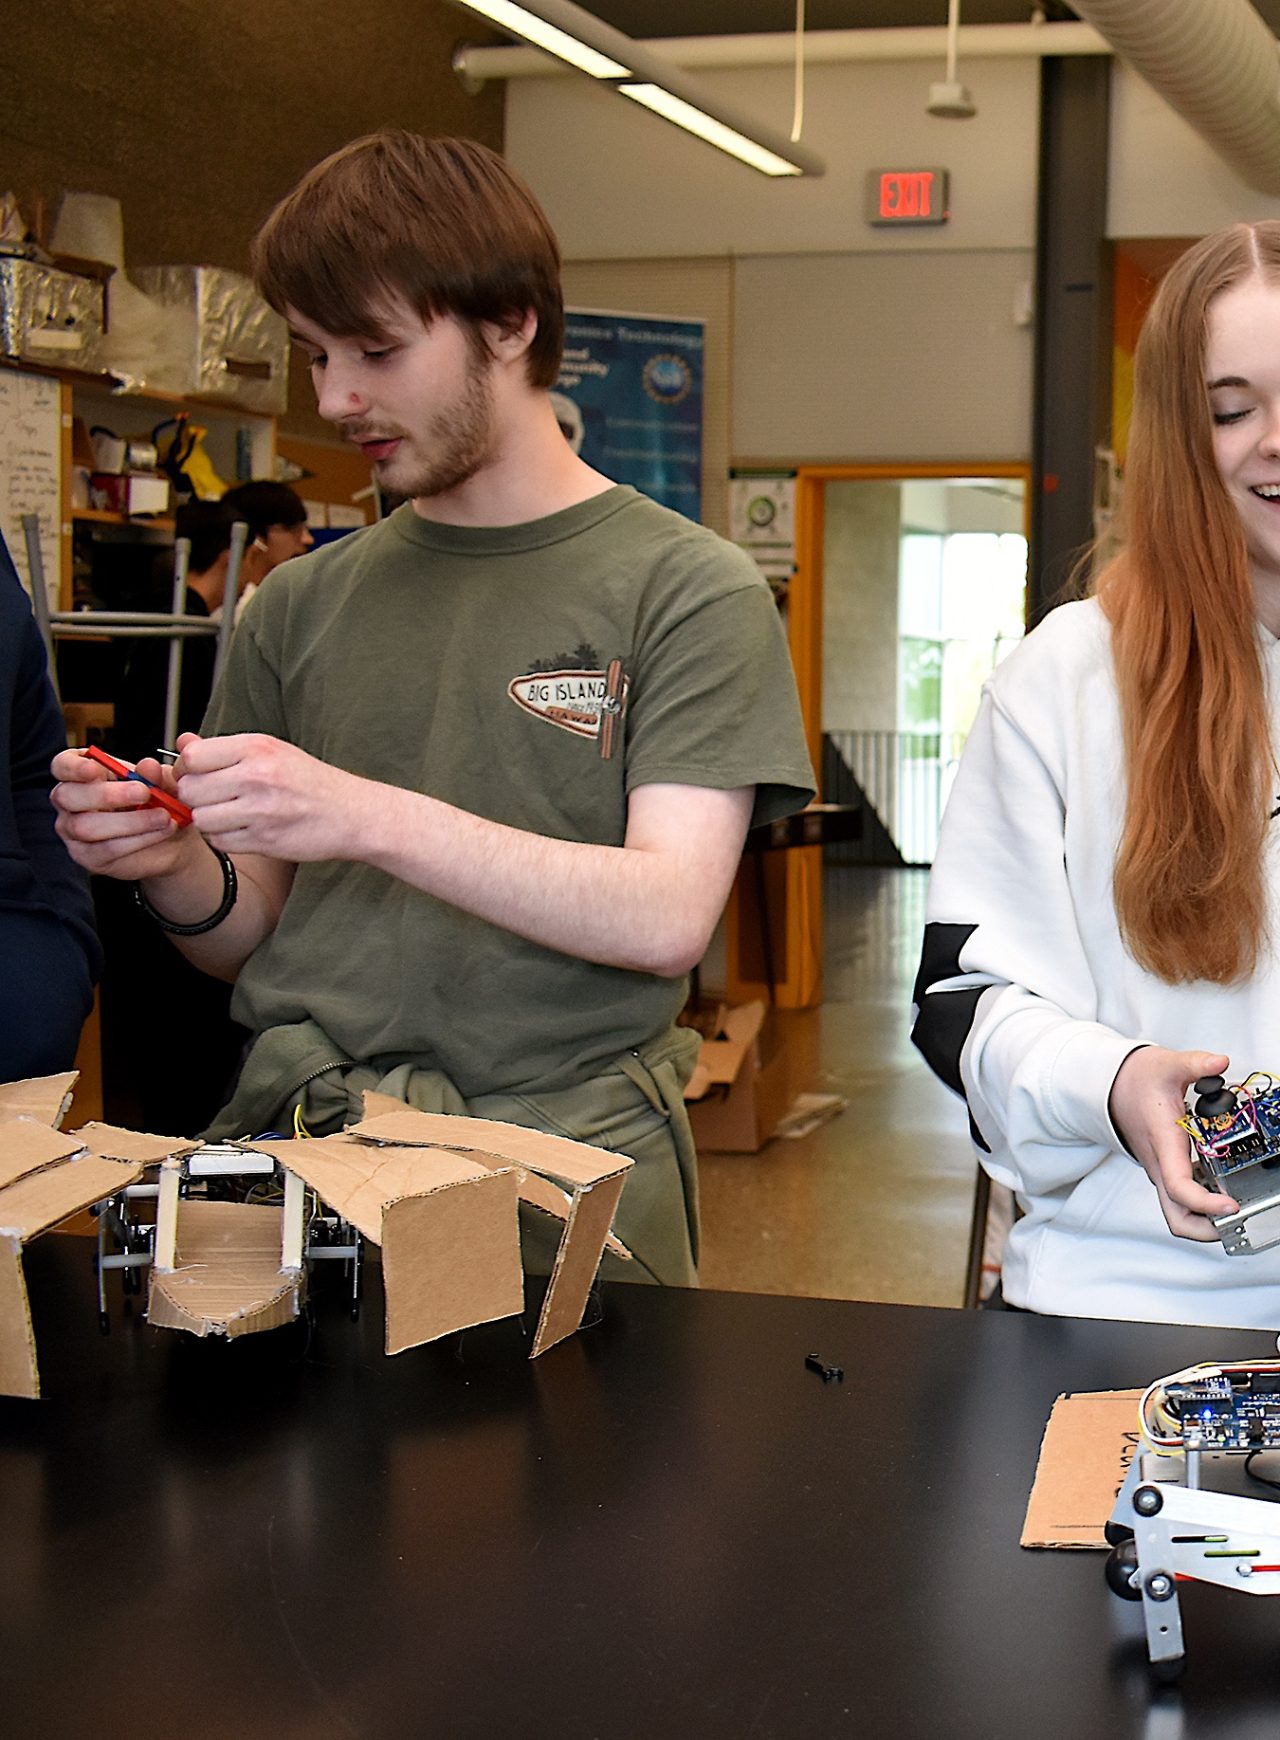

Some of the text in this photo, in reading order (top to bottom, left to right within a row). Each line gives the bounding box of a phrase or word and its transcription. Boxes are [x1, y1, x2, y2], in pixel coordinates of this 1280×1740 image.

[880, 171, 934, 217] EXIT
[527, 681, 607, 702] BIG ISLAND
